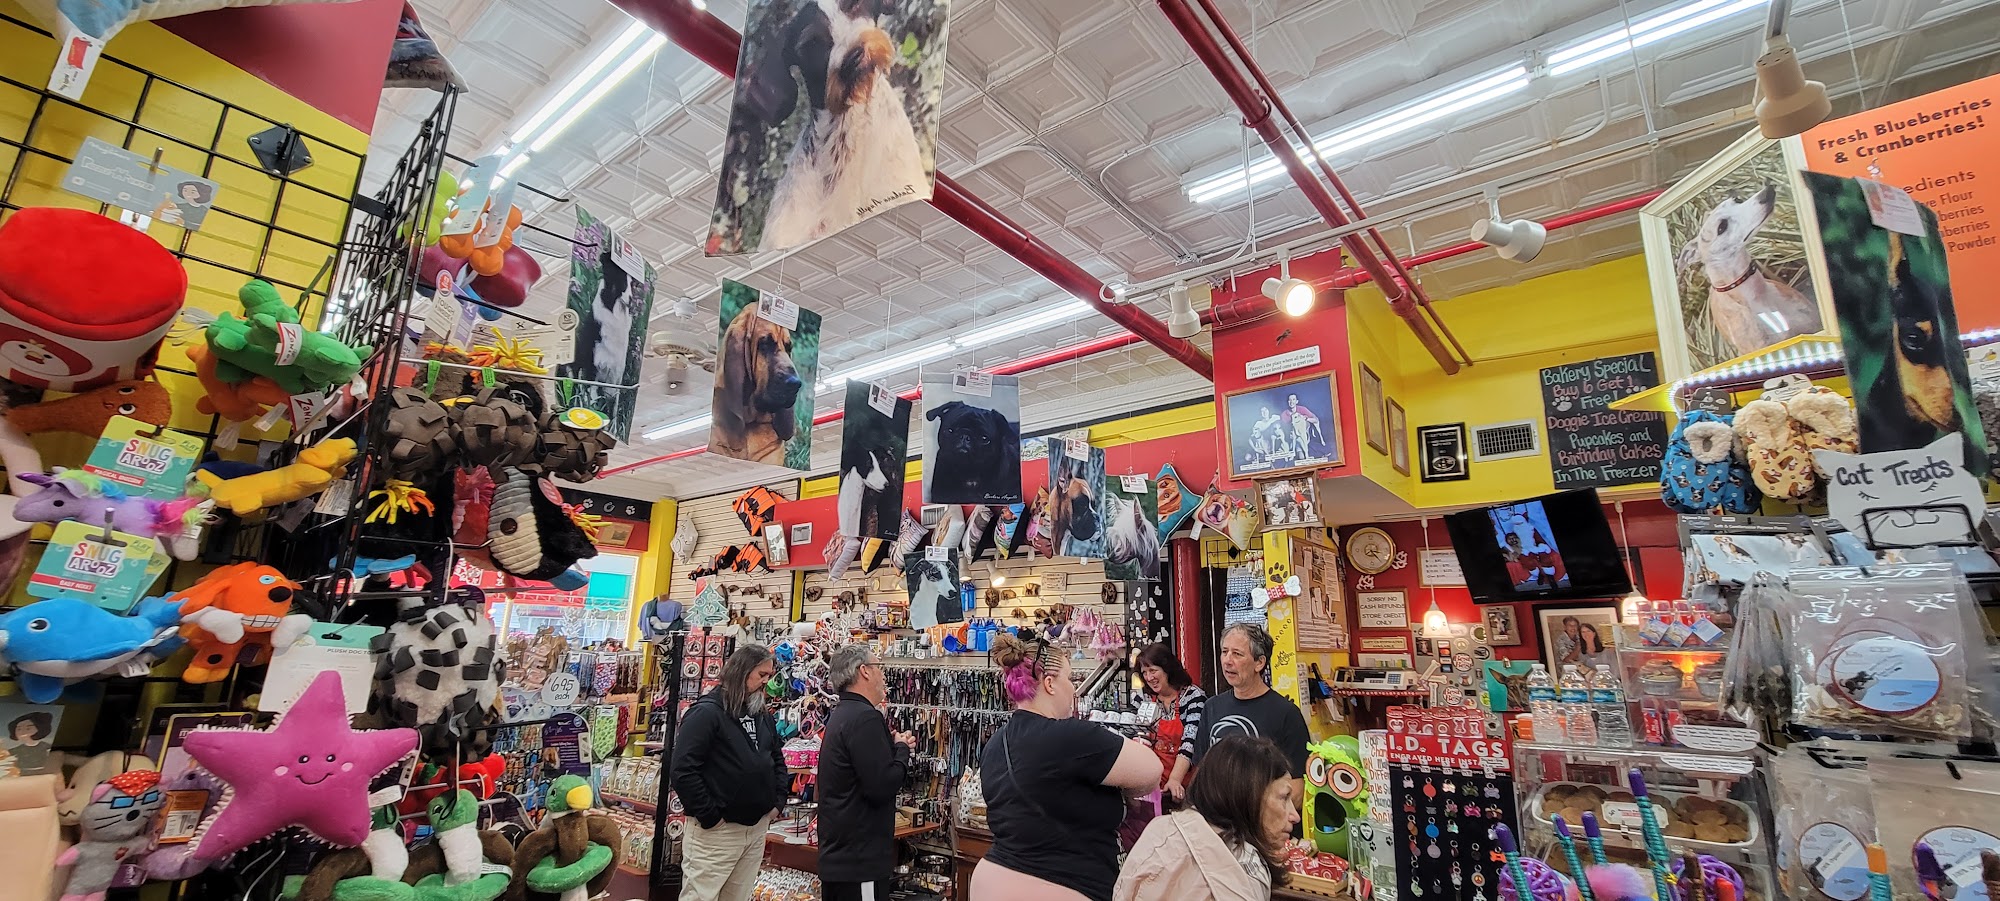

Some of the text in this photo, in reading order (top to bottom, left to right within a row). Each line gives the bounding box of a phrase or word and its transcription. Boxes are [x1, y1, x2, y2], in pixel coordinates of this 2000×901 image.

[1818, 97, 1992, 151] Fresh Blueberries
[1834, 115, 1985, 164] & Cranberries!
[1902, 170, 1976, 195] edients
[1939, 190, 1974, 206] Flour
[1937, 204, 1985, 222] berries
[1947, 235, 1997, 253] Powder
[1542, 366, 1590, 386] Bakery
[1553, 375, 1636, 400] Buy 6 Get 1
[294, 398, 314, 424] Zani
[1547, 413, 1590, 432] Doggie
[1591, 411, 1617, 427] Ice
[181, 440, 200, 454] PLAY
[1569, 427, 1653, 449] Pupcakes and
[125, 438, 173, 461] SNUG
[1558, 443, 1663, 466] Birthday Cakes
[1553, 469, 1572, 484] In
[1569, 466, 1598, 480] The
[1836, 456, 1955, 486] Cat Treats
[74, 541, 123, 564] SNUG
[132, 539, 152, 552] PLAY
[550, 677, 575, 692] 695
[554, 690, 570, 700] each
[1390, 752, 1433, 763] ENGRAVED
[1434, 755, 1456, 764] HERE
[1437, 738, 1505, 758] TAGS
